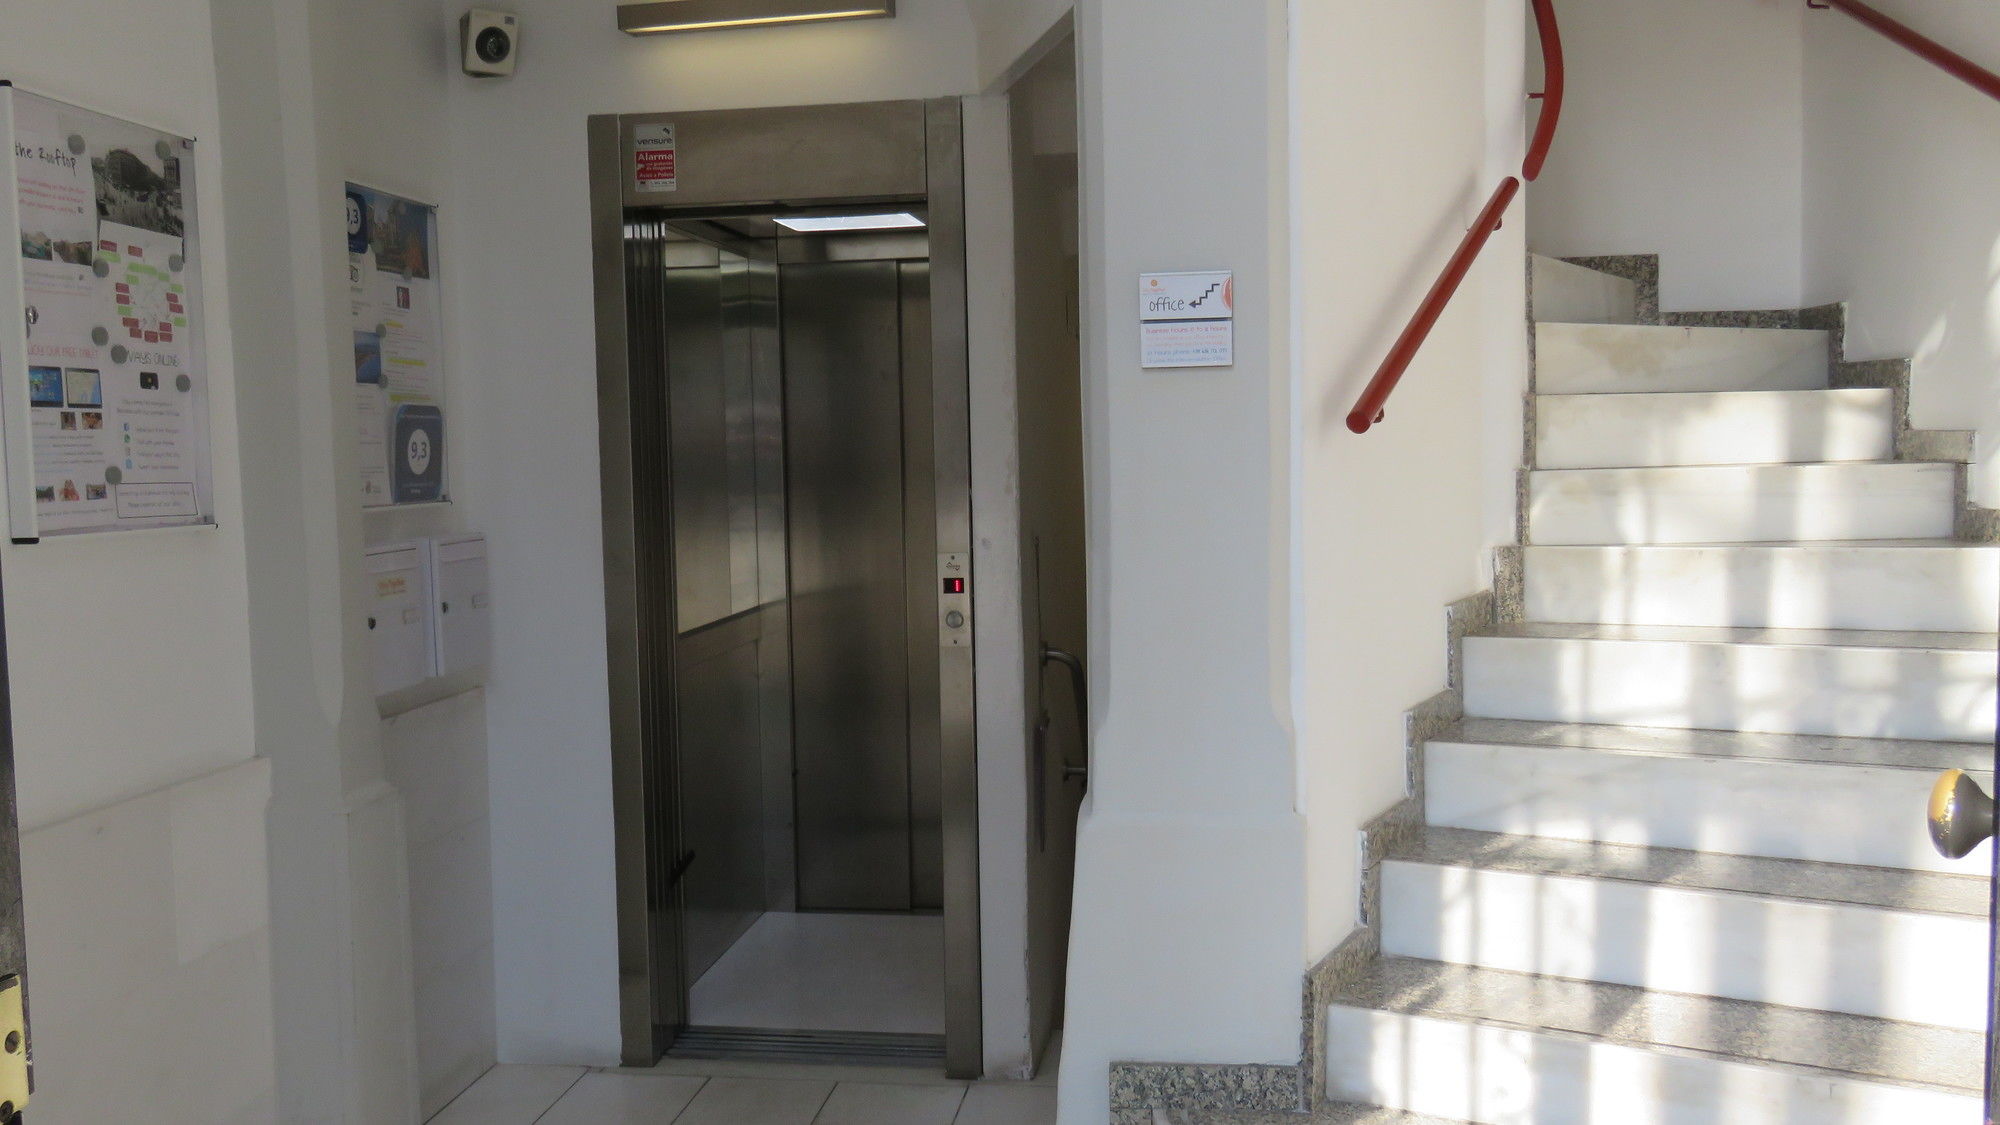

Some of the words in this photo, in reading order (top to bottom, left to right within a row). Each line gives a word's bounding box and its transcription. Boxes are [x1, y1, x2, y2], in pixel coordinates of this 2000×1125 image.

[638, 152, 673, 161] Alarma
[1149, 297, 1185, 312] office
[411, 441, 428, 461] 9,3
